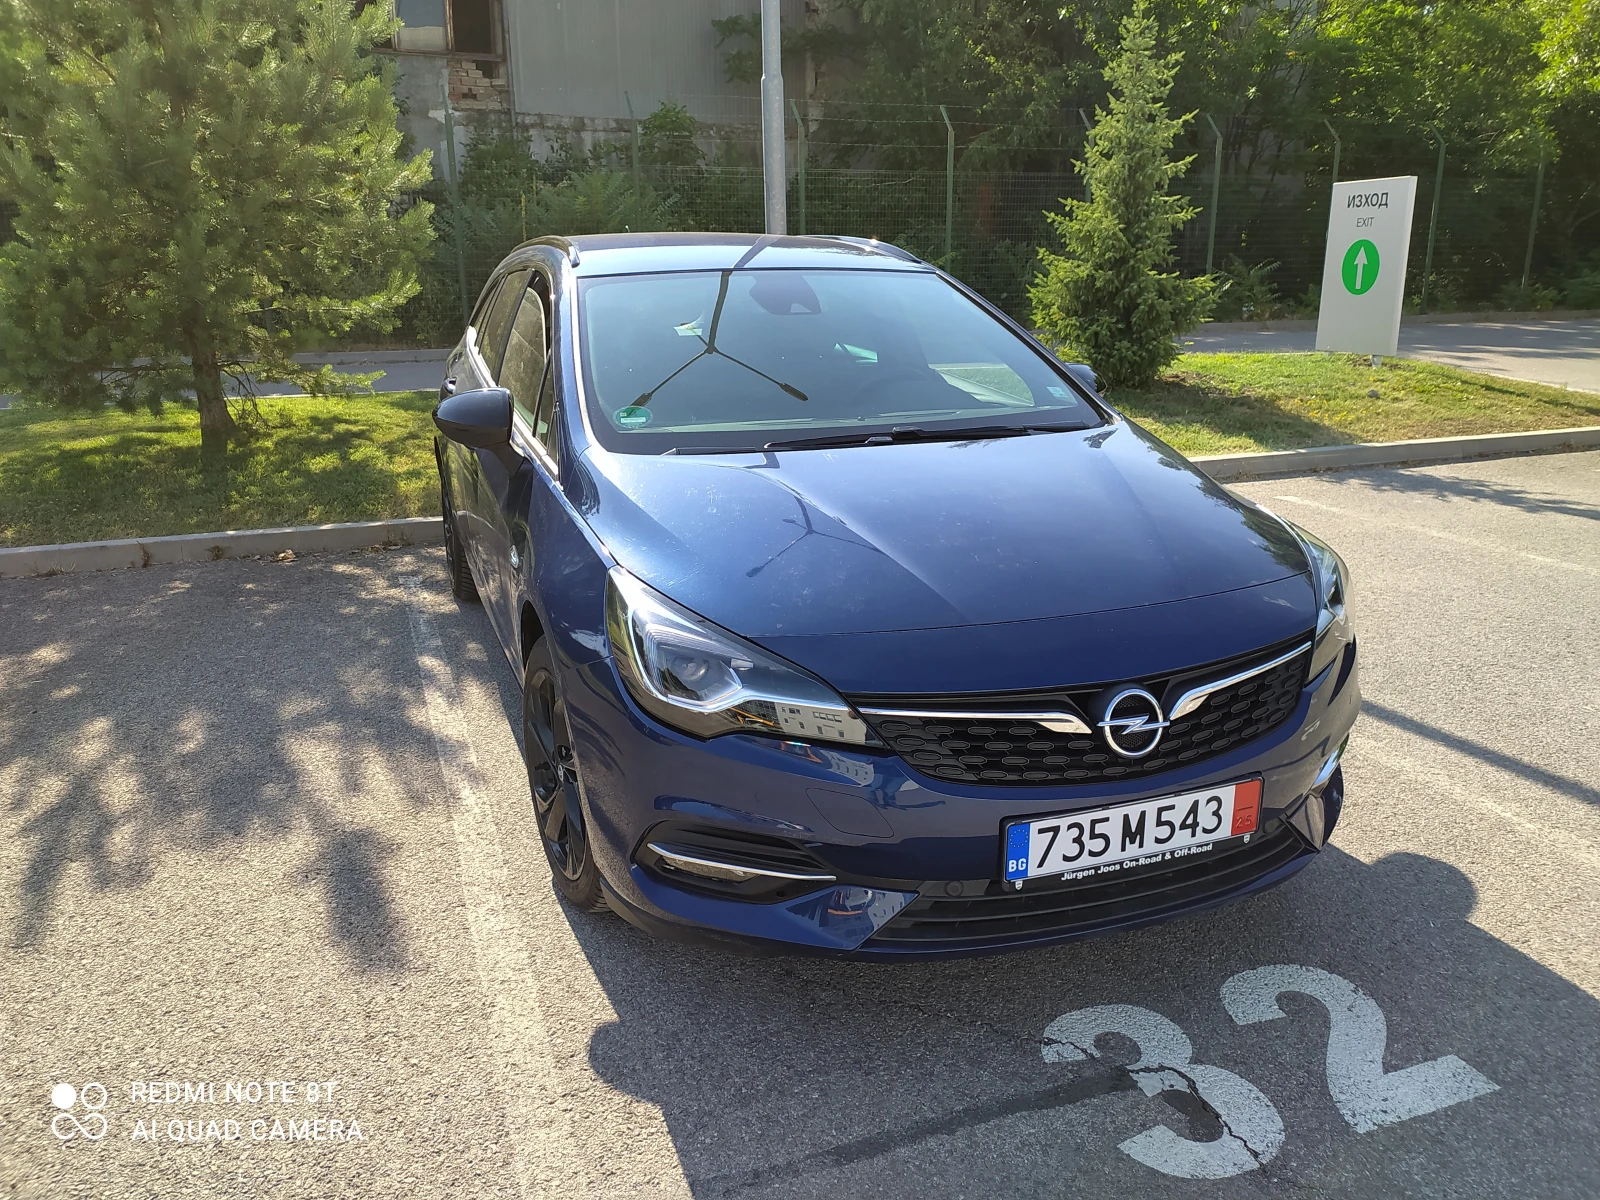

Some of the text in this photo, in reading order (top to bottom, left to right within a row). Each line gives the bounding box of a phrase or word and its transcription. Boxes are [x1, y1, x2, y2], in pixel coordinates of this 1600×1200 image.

[1347, 192, 1389, 209] ИЗХОД
[1356, 217, 1374, 228] EXIT
[1235, 814, 1252, 828] 25
[1036, 795, 1223, 869] 735 M 543
[1008, 857, 1027, 872] BG
[1061, 843, 1213, 881] Jürgen Joos On-Road & Off-Road
[1041, 963, 1501, 1179] 32
